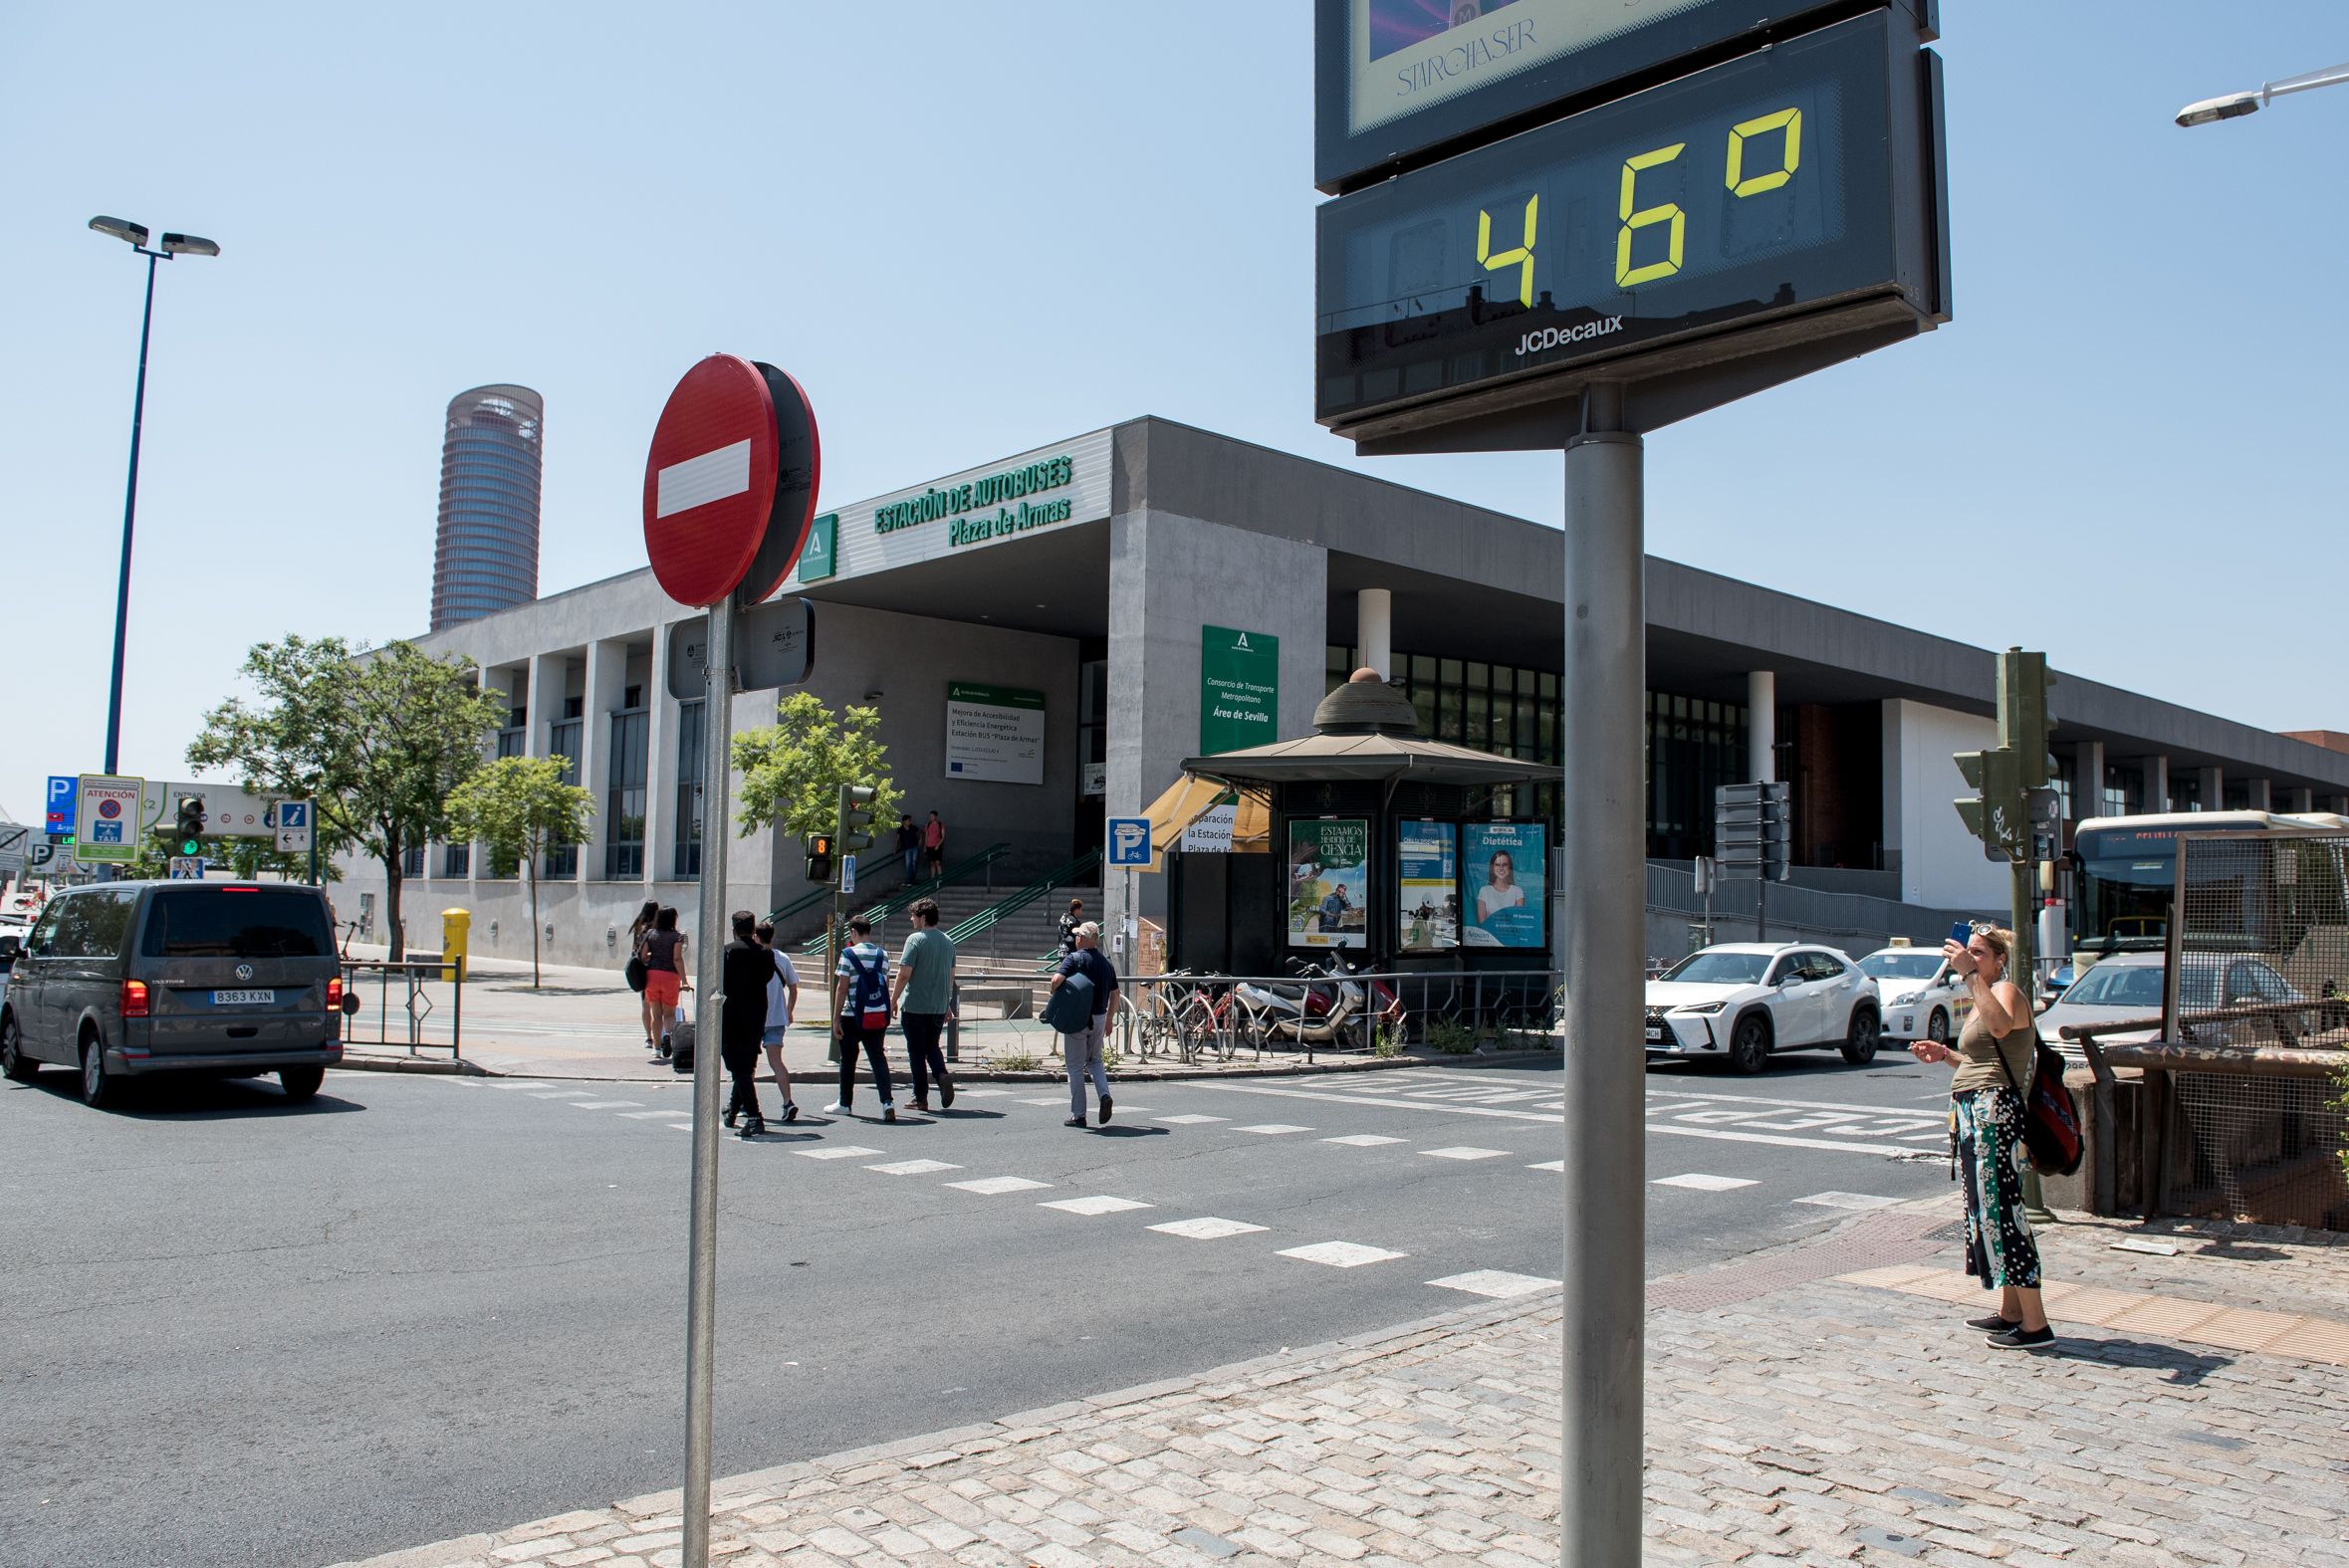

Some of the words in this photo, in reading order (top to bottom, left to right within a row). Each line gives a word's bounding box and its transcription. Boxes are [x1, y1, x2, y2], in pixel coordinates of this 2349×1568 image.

[1396, 18, 1538, 97] STARCHASER
[1515, 315, 1624, 356] JCDecaux
[874, 487, 947, 535] ESTACIÓN
[948, 484, 972, 515] DE
[971, 455, 1072, 507] AUTOBUSES
[948, 519, 989, 548] Plaza
[991, 508, 1015, 536] de
[1017, 498, 1071, 530] Armas
[1207, 677, 1236, 688] Consorcio
[1236, 681, 1244, 690] de
[1245, 682, 1275, 694] Transporte
[1221, 691, 1262, 704] Metropolitano
[952, 708, 972, 717] Mejora
[982, 711, 1021, 722] Accesibilidad
[1213, 705, 1232, 719] Área
[1233, 709, 1243, 720] de
[1244, 710, 1269, 723] Sevilla
[956, 719, 986, 729] Eficiencia
[986, 722, 1018, 732] Energética
[50, 779, 71, 803] P
[87, 788, 136, 799] ATENCIÓN
[1188, 827, 1196, 838] la
[1197, 828, 1231, 840] Estación
[1320, 826, 1363, 836] ESTAMOS
[98, 834, 118, 843] TAXI
[1482, 836, 1524, 846] Dietética
[818, 838, 826, 854] 8
[1320, 844, 1362, 856] CIENCIA
[217, 992, 246, 1002] 8363
[250, 991, 272, 1002] KXN
